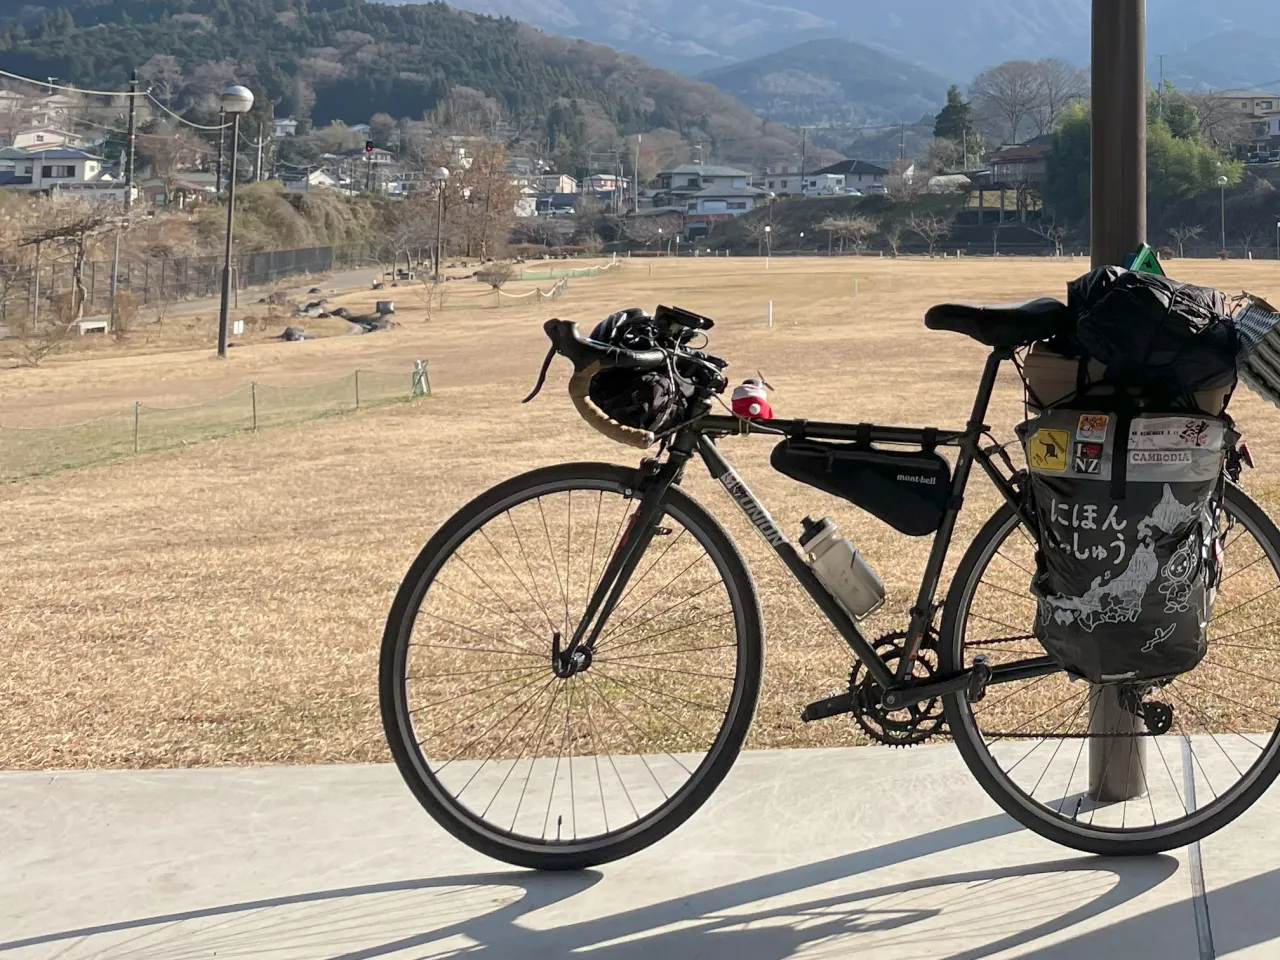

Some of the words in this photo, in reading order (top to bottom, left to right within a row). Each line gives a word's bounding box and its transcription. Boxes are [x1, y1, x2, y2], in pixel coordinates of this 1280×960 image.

[1074, 458, 1099, 473] NZ
[1132, 452, 1190, 462] CAMBODIA
[1050, 498, 1127, 531] にほん
[1044, 531, 1126, 565] いっしゅう
